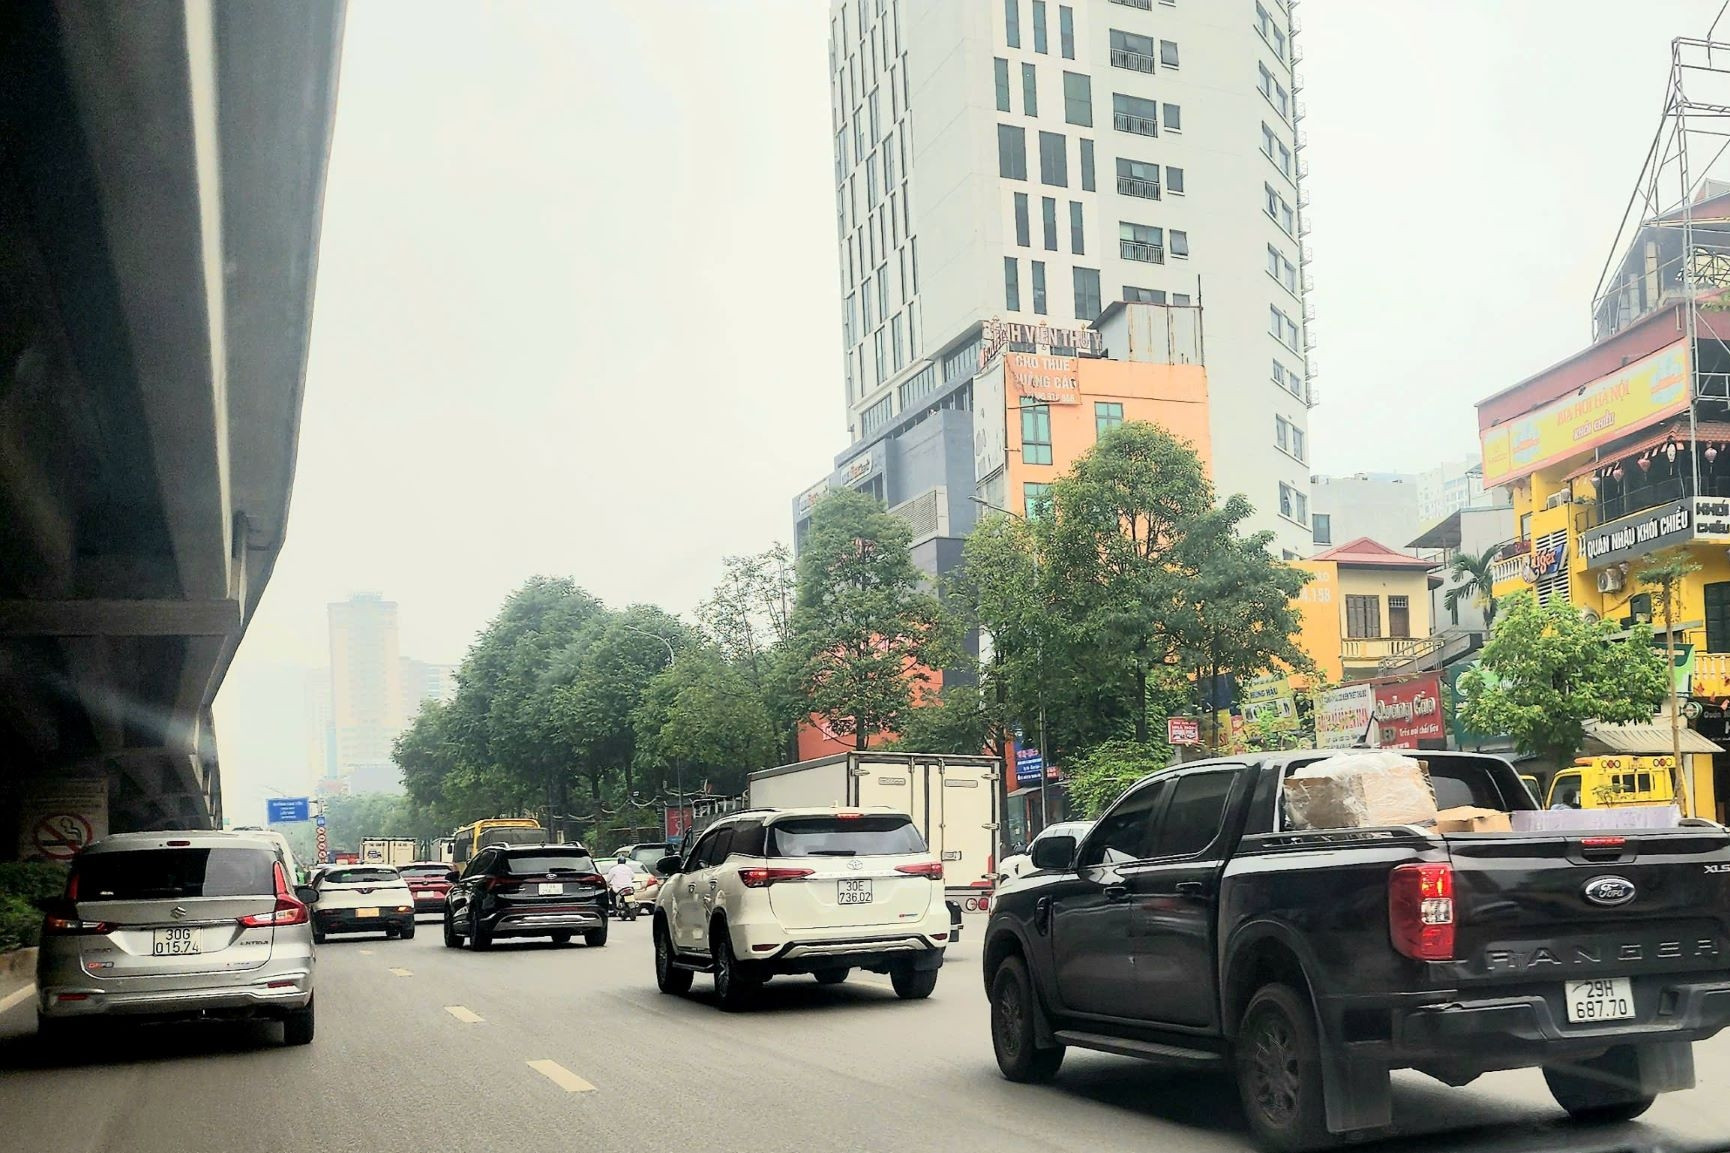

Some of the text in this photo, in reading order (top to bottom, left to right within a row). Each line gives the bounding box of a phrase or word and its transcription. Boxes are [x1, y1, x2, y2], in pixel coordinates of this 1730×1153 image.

[1587, 535, 1610, 559] QUÁN
[1611, 525, 1635, 550] NHẬU
[1636, 518, 1659, 544] KHÓI
[1660, 506, 1688, 533] CHIỀU
[1531, 550, 1556, 574] Tiger
[846, 881, 864, 892] 30E
[1600, 882, 1626, 898] Ford
[839, 892, 871, 904] 736.02
[165, 928, 191, 940] 30G
[155, 940, 200, 954] 015.74
[1487, 938, 1719, 970] RANGER
[1587, 979, 1614, 998] 29H
[1576, 999, 1628, 1019] 687.70
